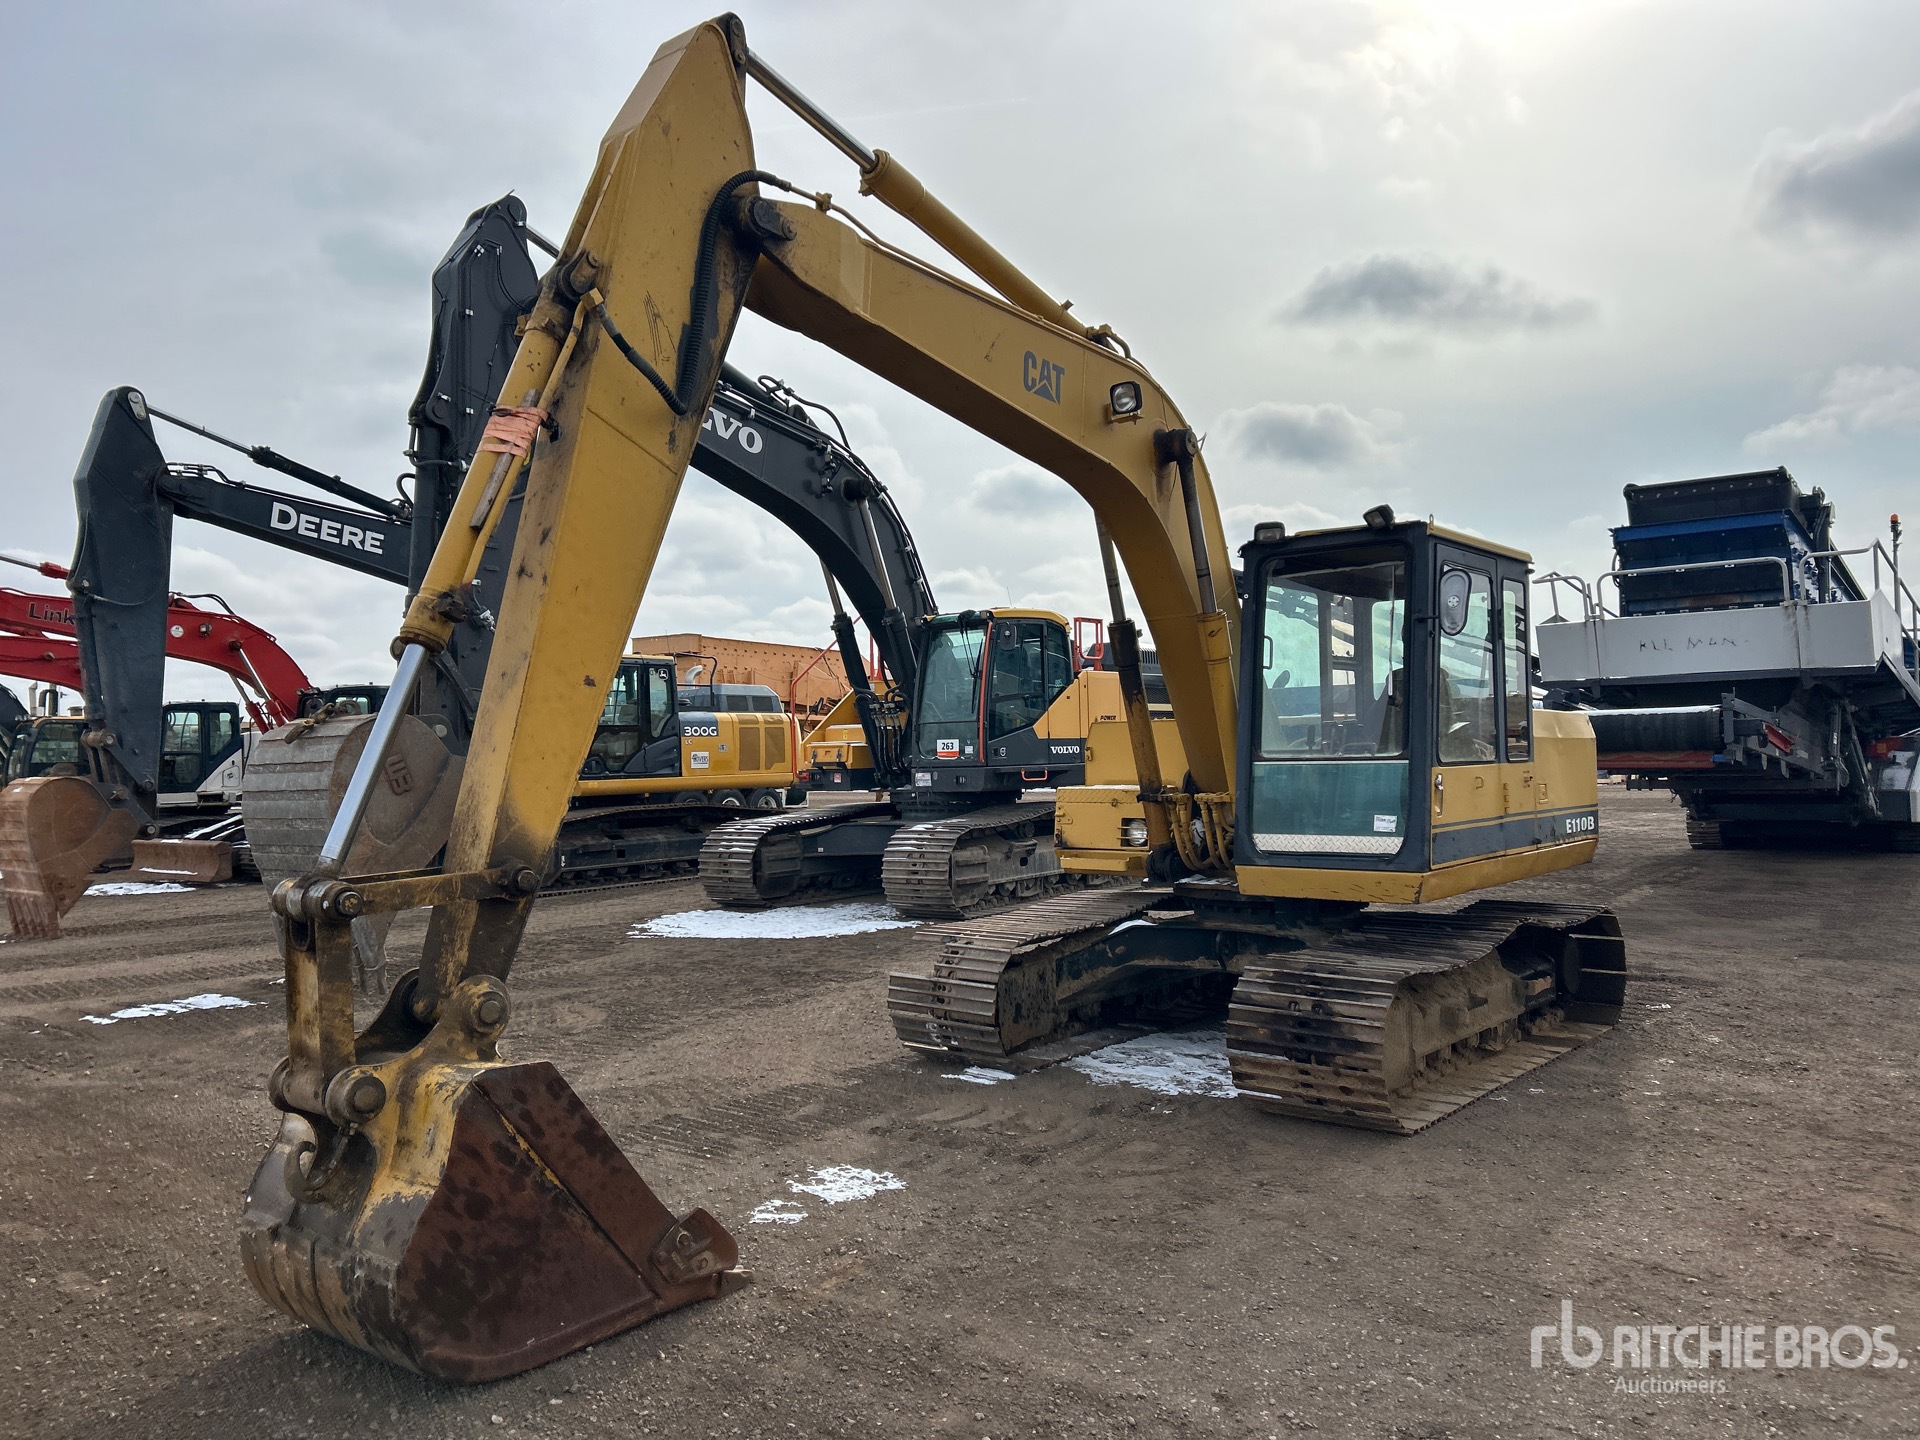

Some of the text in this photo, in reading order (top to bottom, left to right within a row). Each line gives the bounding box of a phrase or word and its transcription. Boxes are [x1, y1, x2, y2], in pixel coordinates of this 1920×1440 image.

[1024, 351, 1065, 405] CAT
[702, 406, 763, 454] VO
[270, 501, 385, 555] DEERE
[683, 726, 717, 737] 300G
[941, 742, 954, 750] 263
[1051, 745, 1080, 754] VOLVO
[1566, 816, 1595, 834] E110B
